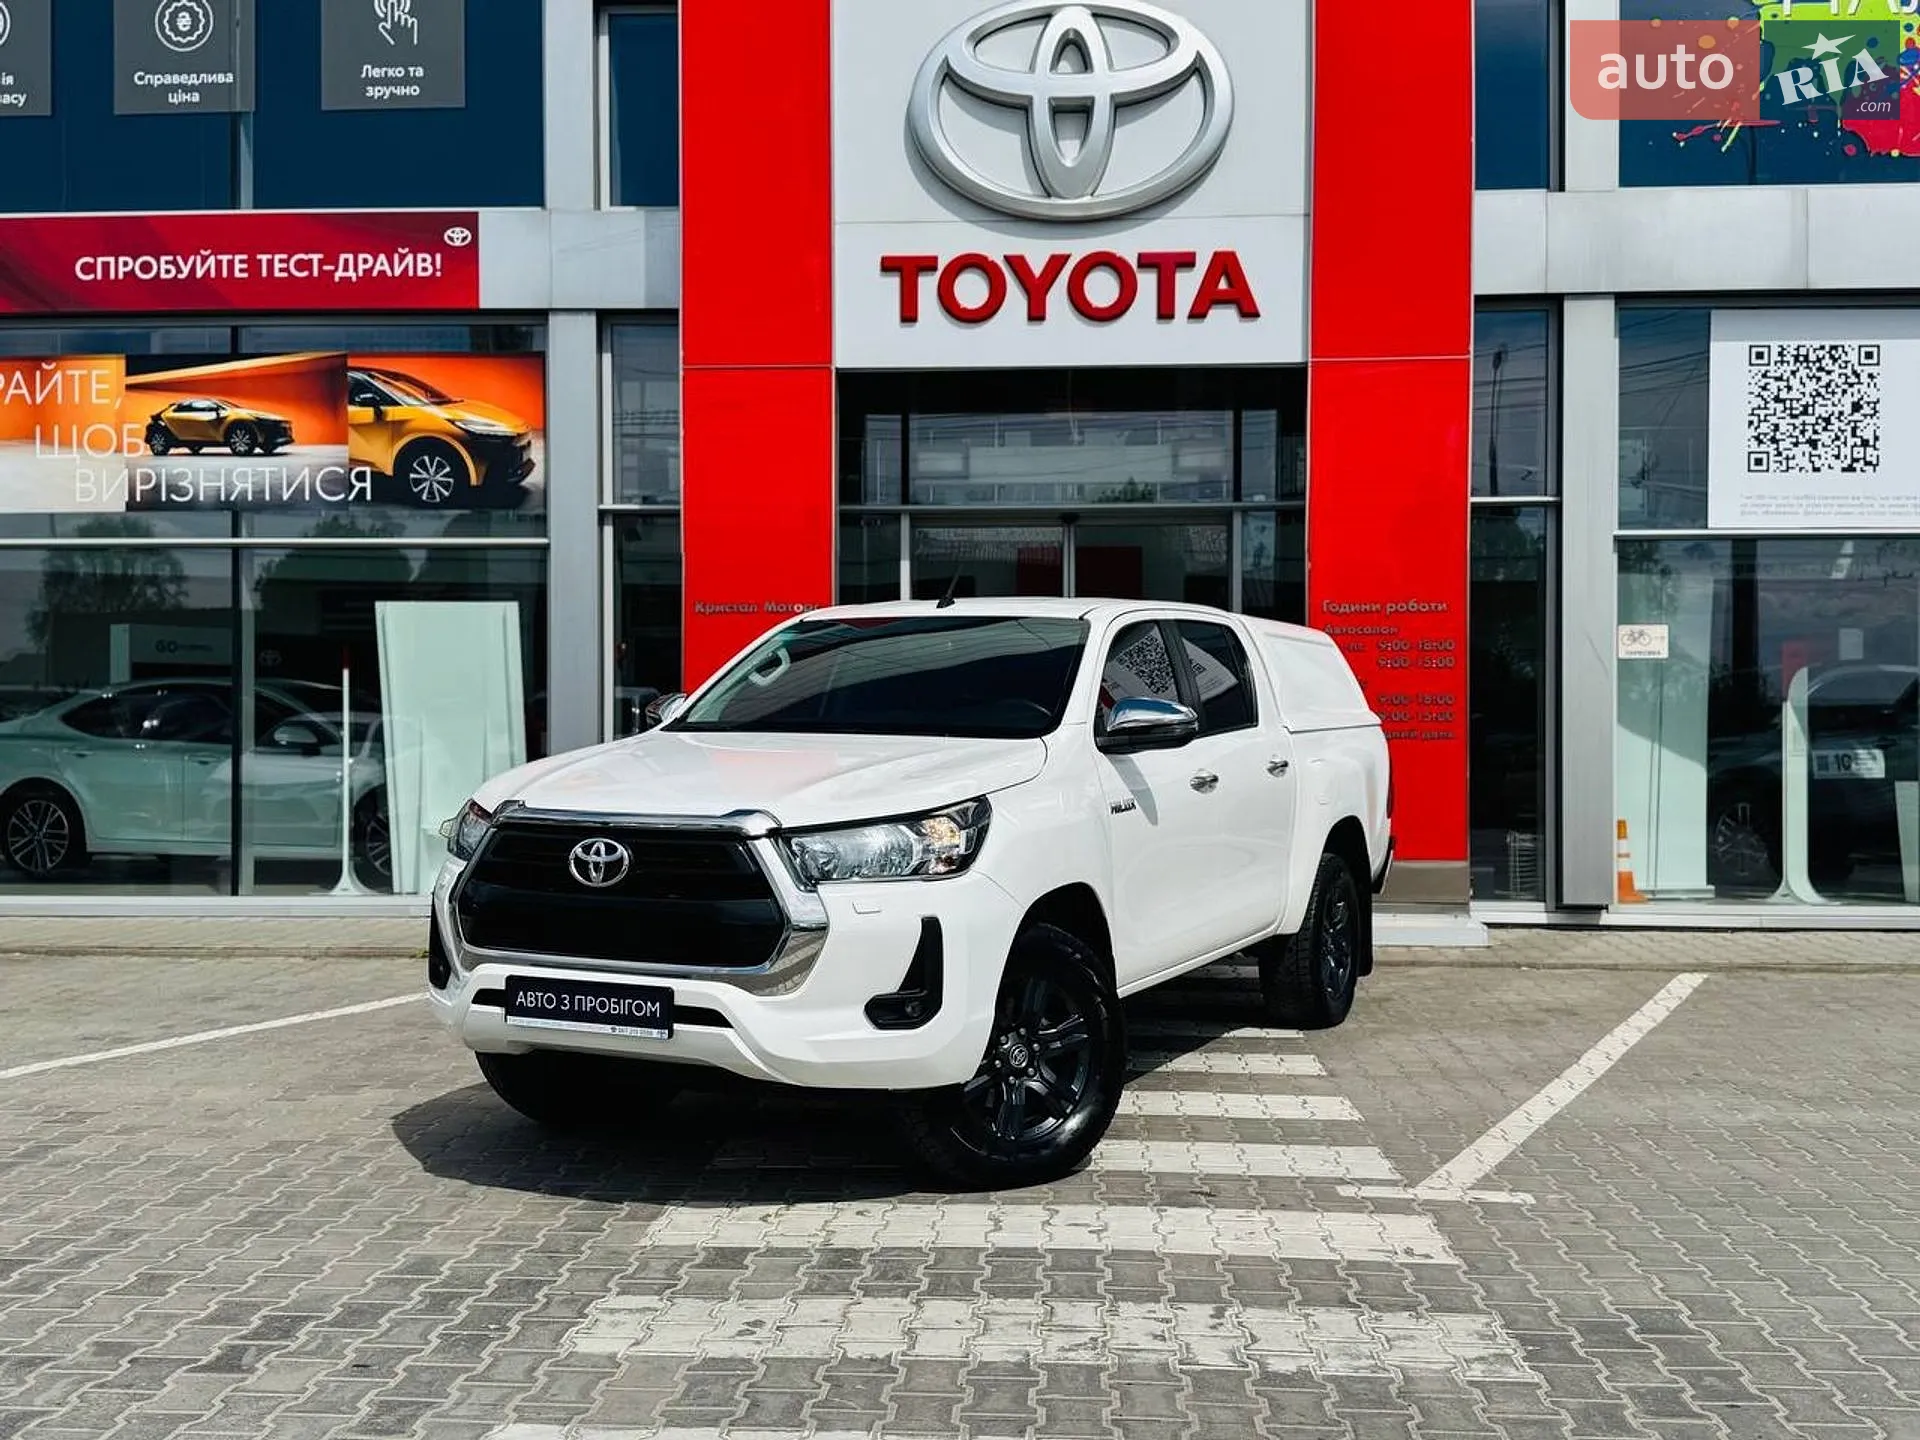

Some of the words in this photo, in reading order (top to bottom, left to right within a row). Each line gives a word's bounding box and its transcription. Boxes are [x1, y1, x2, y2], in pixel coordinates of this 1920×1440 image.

[134, 71, 233, 87] Справедлива
[361, 64, 405, 79] Легко
[408, 65, 424, 78] та
[0, 93, 27, 108] асу
[168, 90, 200, 104] ціна
[365, 85, 420, 99] зручно
[74, 249, 249, 281] СПРОБУЙТЕ
[256, 247, 443, 283] ТЕСТ-ДРАЙВ!
[880, 250, 1261, 323] TOYOTA
[35, 422, 146, 465] ЩОБ
[75, 464, 373, 505] ВИРІЗНЯТИСЯ
[1323, 599, 1381, 613] Години
[1385, 598, 1448, 615] роботи
[516, 991, 556, 1009] АВТО
[575, 995, 660, 1018] ПРОБІГОМ
